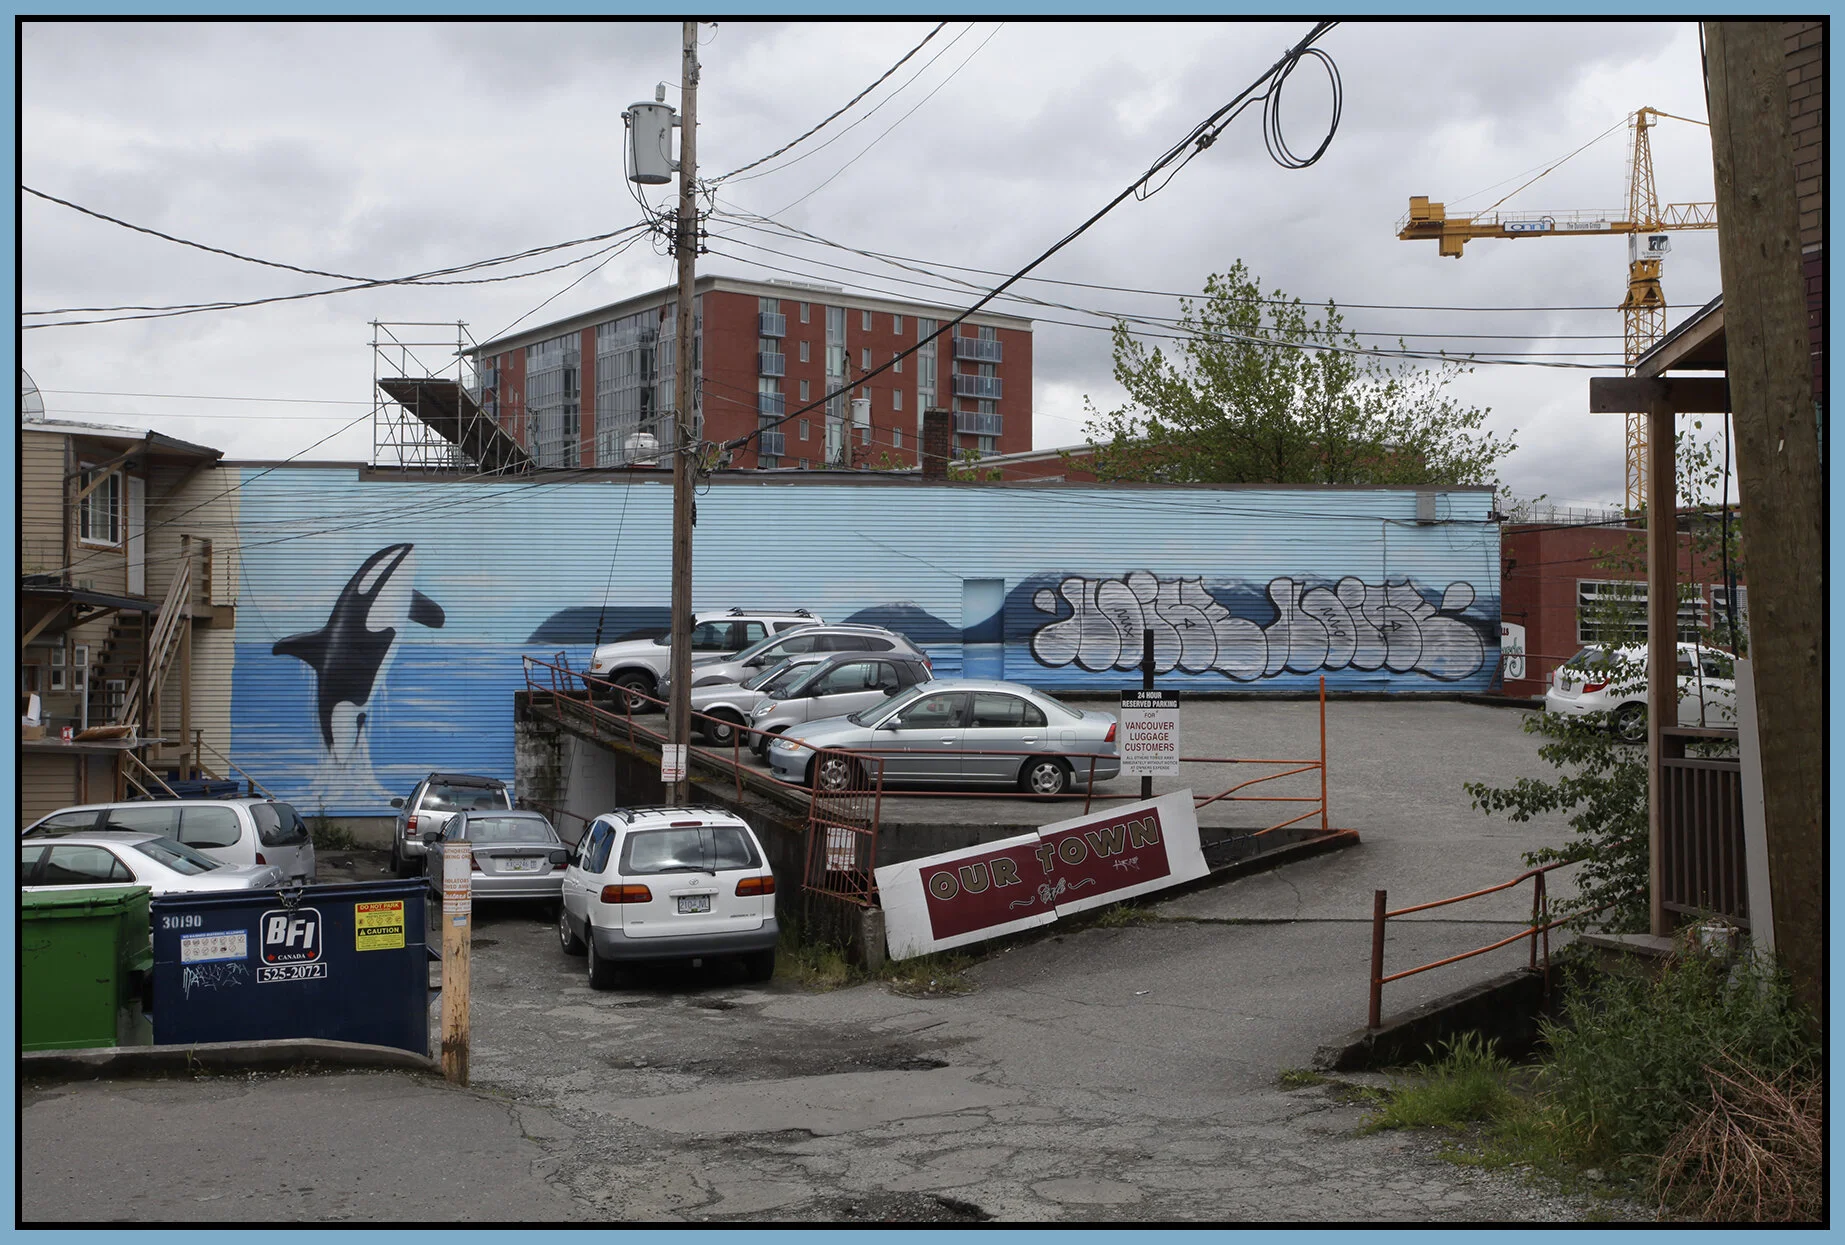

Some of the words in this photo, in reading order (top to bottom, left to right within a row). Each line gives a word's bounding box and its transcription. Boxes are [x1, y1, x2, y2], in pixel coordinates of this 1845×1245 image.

[1145, 691, 1162, 699] HOUR
[1124, 721, 1175, 730] VANCOUVER
[1129, 732, 1169, 741] LUGGAGE
[1124, 742, 1175, 752] CUSTOMERS
[928, 857, 1022, 901] OUR
[1035, 816, 1160, 874] TOWN
[162, 915, 202, 929] 30190
[266, 916, 315, 949] BFI
[366, 926, 400, 935] CAUTION
[277, 953, 306, 961] CANADA
[263, 965, 321, 981] 525-2072
